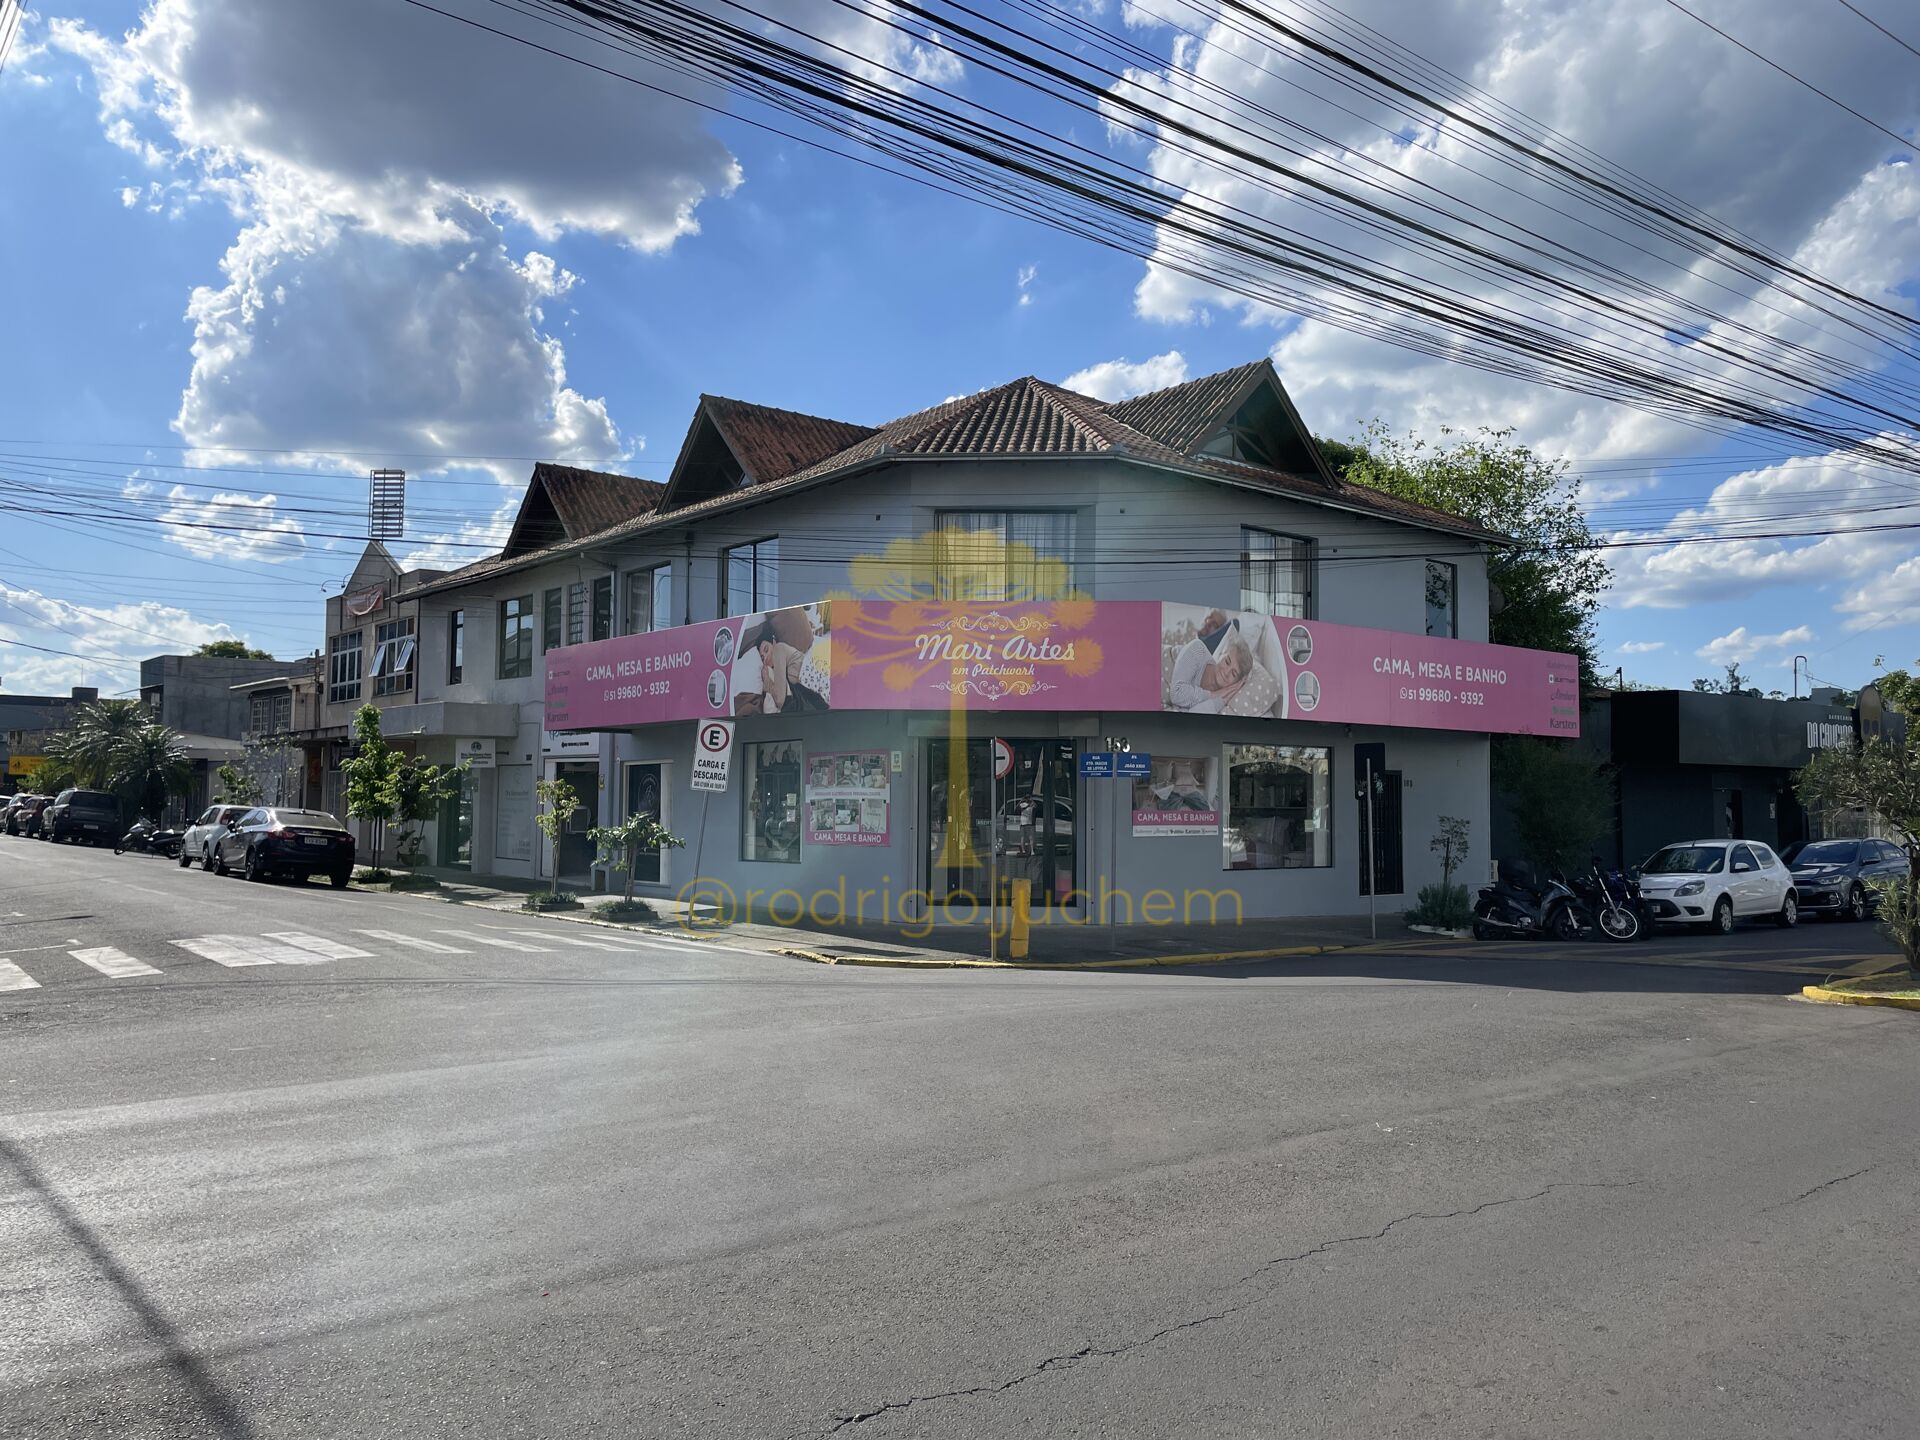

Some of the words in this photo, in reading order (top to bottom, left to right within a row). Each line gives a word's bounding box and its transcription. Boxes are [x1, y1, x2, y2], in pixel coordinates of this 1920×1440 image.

[914, 634, 993, 661] Mari
[1002, 635, 1075, 661] Artes
[586, 664, 614, 681] CAMA,
[617, 660, 642, 677] MESA
[646, 658, 651, 672] E
[654, 651, 692, 671] BANHO
[952, 666, 969, 676] em
[972, 664, 1035, 677] Patchwork
[1373, 657, 1414, 679] CAMA,
[1419, 662, 1452, 679] MESA
[1456, 666, 1462, 680] E
[1466, 666, 1507, 685] BANHO
[617, 684, 642, 700] 99680
[650, 680, 670, 695] 9392
[1408, 690, 1416, 700] 51
[1419, 688, 1450, 703] 99680
[1460, 691, 1484, 705] 9392
[709, 730, 720, 746] E
[698, 760, 719, 769] CARGA
[694, 770, 726, 781] DESCARGA
[1138, 814, 1160, 822] CAMA,
[814, 833, 834, 841] CAMA,
[853, 834, 857, 842] E
[859, 834, 881, 843] BANHO
